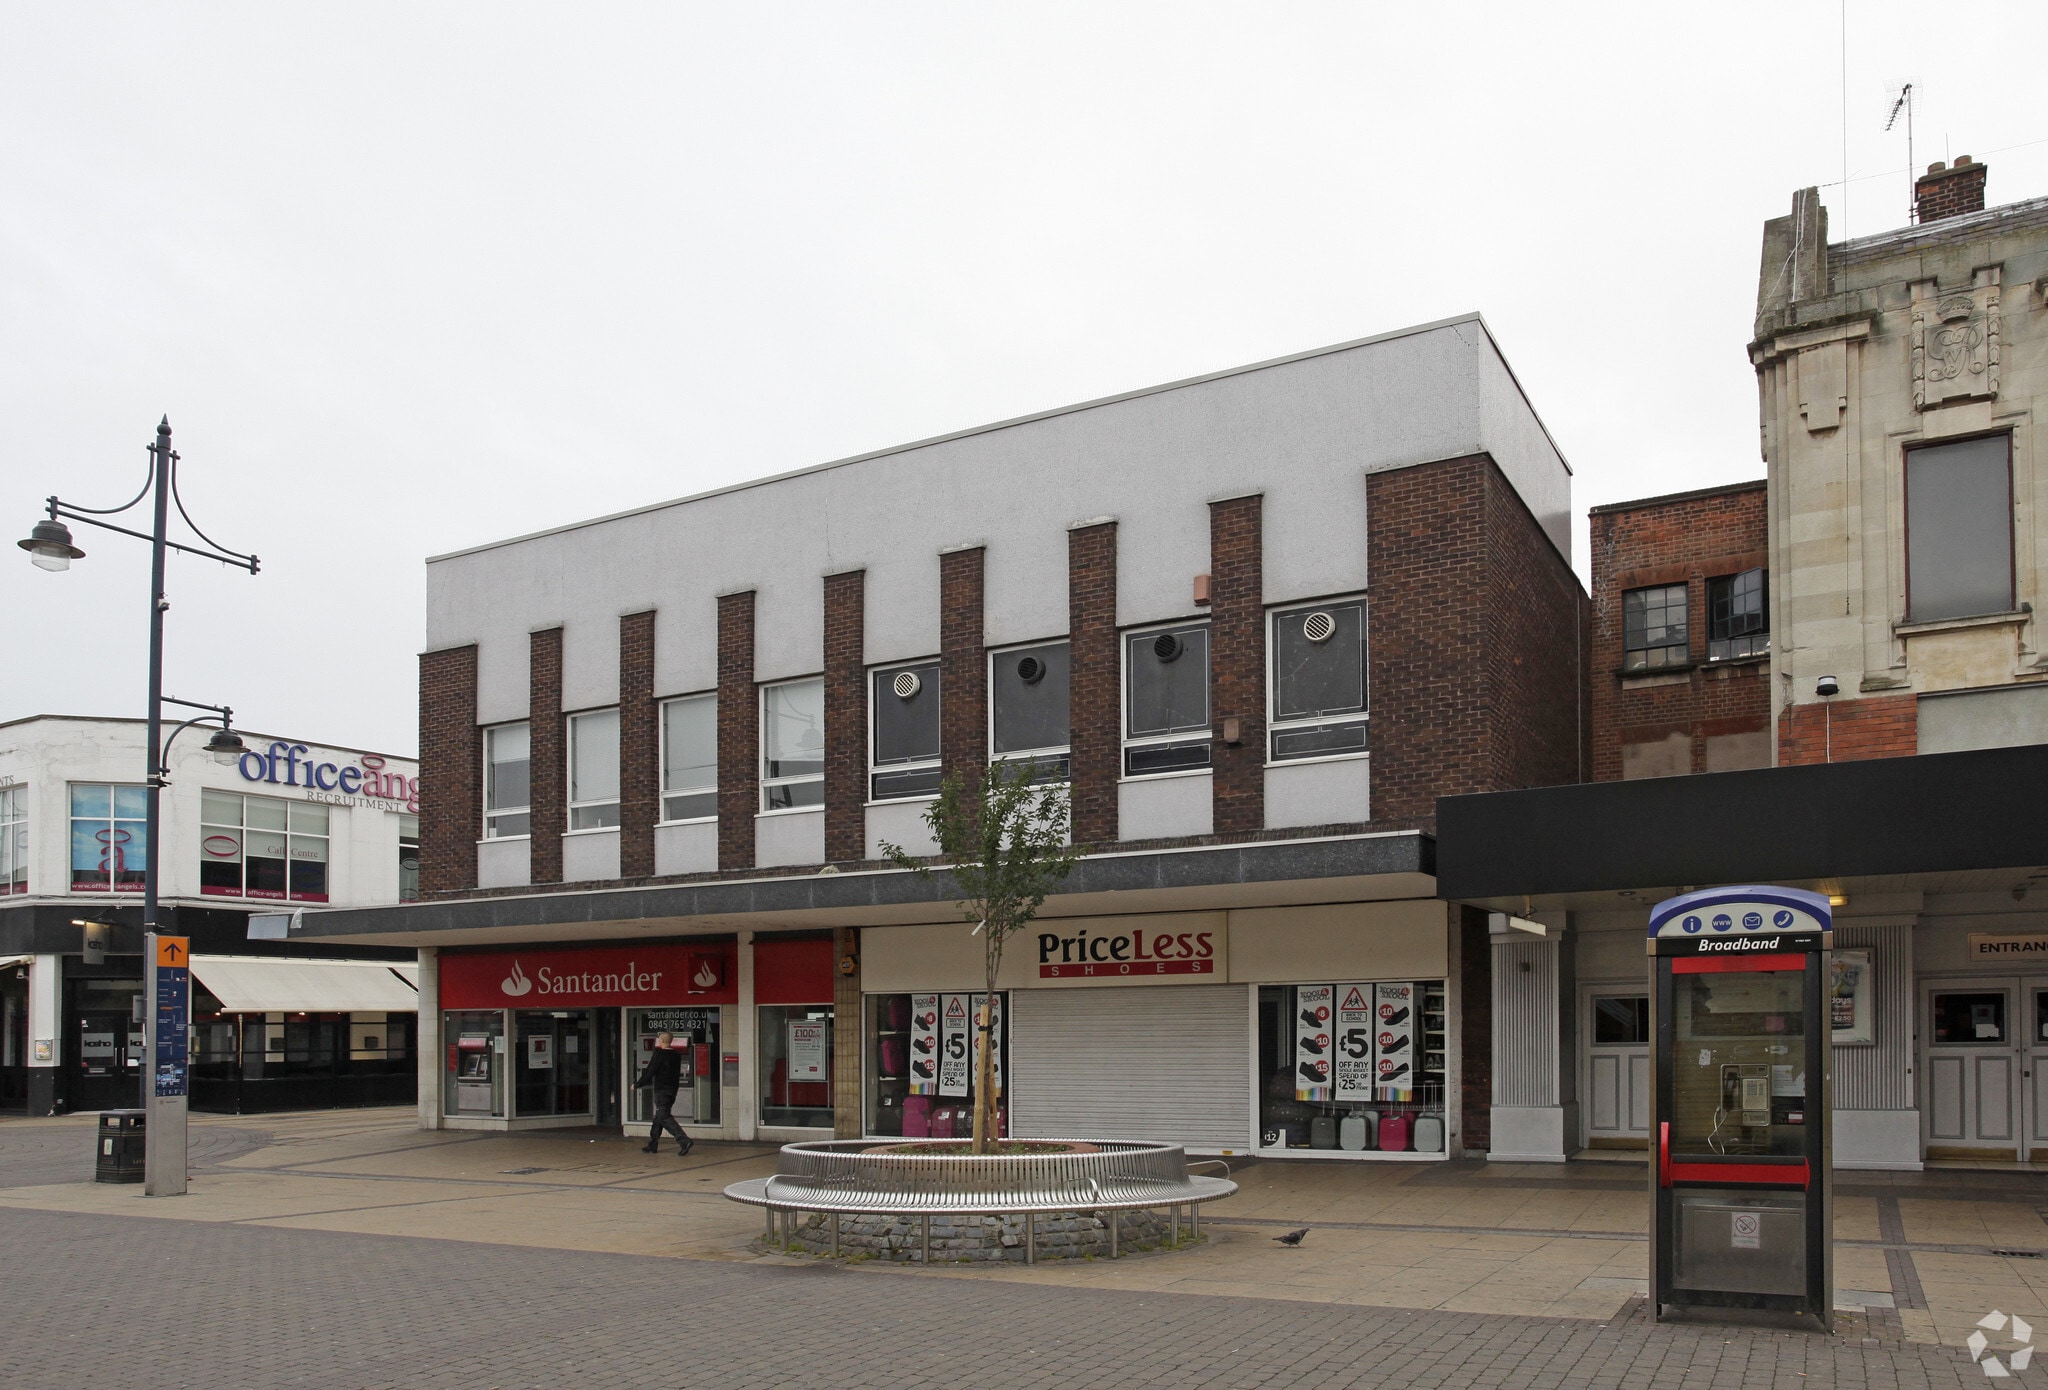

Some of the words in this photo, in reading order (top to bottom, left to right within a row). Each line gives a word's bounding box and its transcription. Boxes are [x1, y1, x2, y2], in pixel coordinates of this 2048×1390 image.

[306, 790, 402, 813] RECRUITMENT
[291, 848, 318, 858] Centre
[1038, 929, 1214, 963] PriceLess
[1698, 936, 1780, 952] Broadband
[1980, 941, 2048, 953] ENTRAN
[538, 961, 662, 994] Santander
[648, 1020, 667, 1029] 0845
[670, 1020, 684, 1029] 765
[686, 1020, 706, 1029] 4321
[945, 1032, 965, 1059] £5
[1339, 1028, 1369, 1059] £5
[1338, 1061, 1352, 1069] OFF
[1353, 1061, 1369, 1069] ANY
